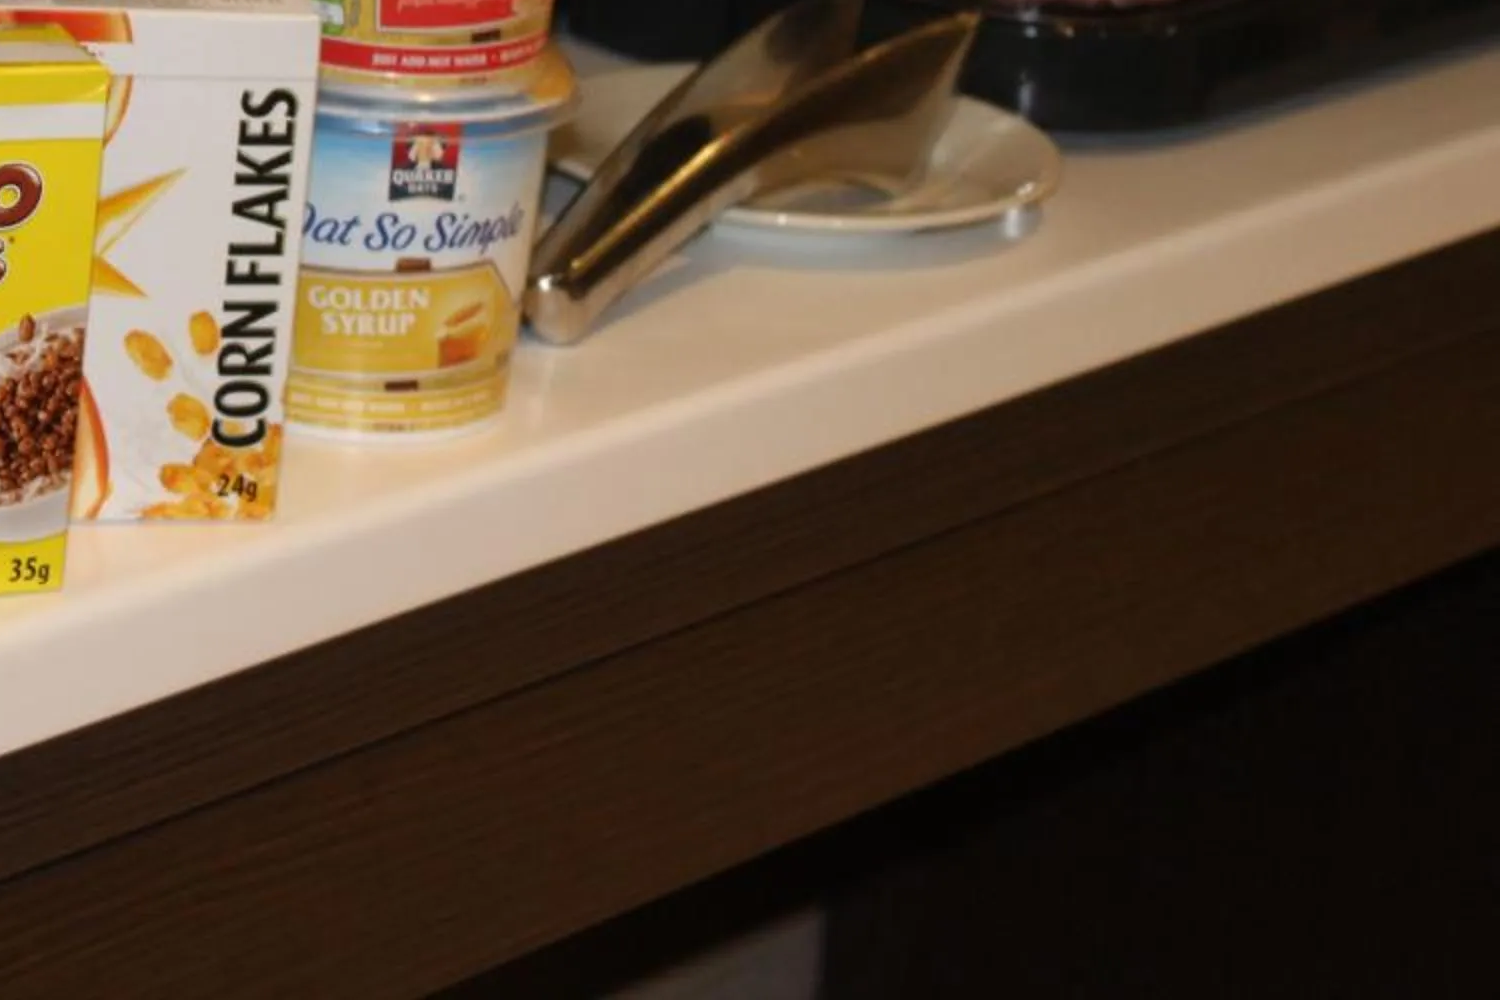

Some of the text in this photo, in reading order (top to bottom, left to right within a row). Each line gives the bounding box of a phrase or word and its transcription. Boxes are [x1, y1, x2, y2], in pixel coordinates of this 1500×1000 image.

[391, 168, 457, 186] QUAKER
[363, 212, 417, 252] So
[423, 202, 526, 255] Simple
[211, 87, 300, 449] CORN FLAKES
[307, 285, 432, 312] GOLDEN
[321, 312, 417, 337] SYRUP
[217, 473, 258, 503] 24g
[8, 555, 51, 585] 35g
